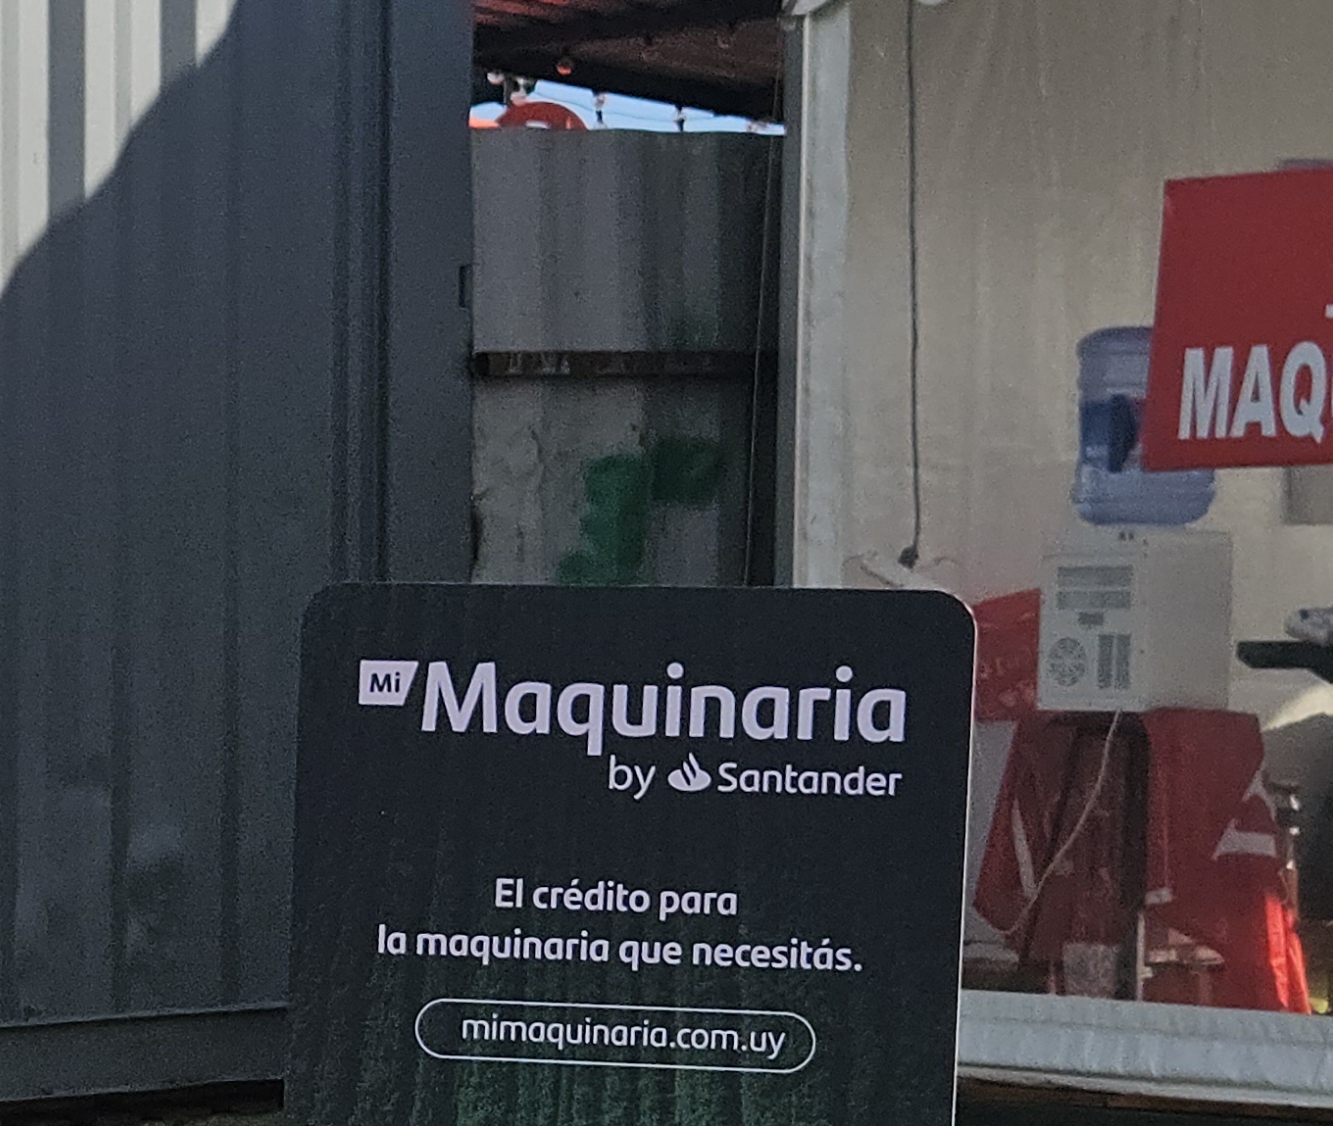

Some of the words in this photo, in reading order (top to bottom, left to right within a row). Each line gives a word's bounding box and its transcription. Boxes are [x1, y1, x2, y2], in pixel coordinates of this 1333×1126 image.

[1178, 341, 1333, 444] MAQ
[369, 671, 402, 694] Mi
[421, 661, 907, 756] Maquinaria
[608, 755, 656, 800] by
[717, 762, 903, 796] Santander
[495, 877, 524, 908] El
[532, 878, 651, 913] crédito
[659, 890, 738, 922] para
[377, 923, 407, 955] la
[416, 927, 610, 966] maquinaria
[618, 940, 683, 972] que
[692, 937, 862, 972] necesitás.
[461, 1014, 786, 1060] mimaquinaria.com.uy
